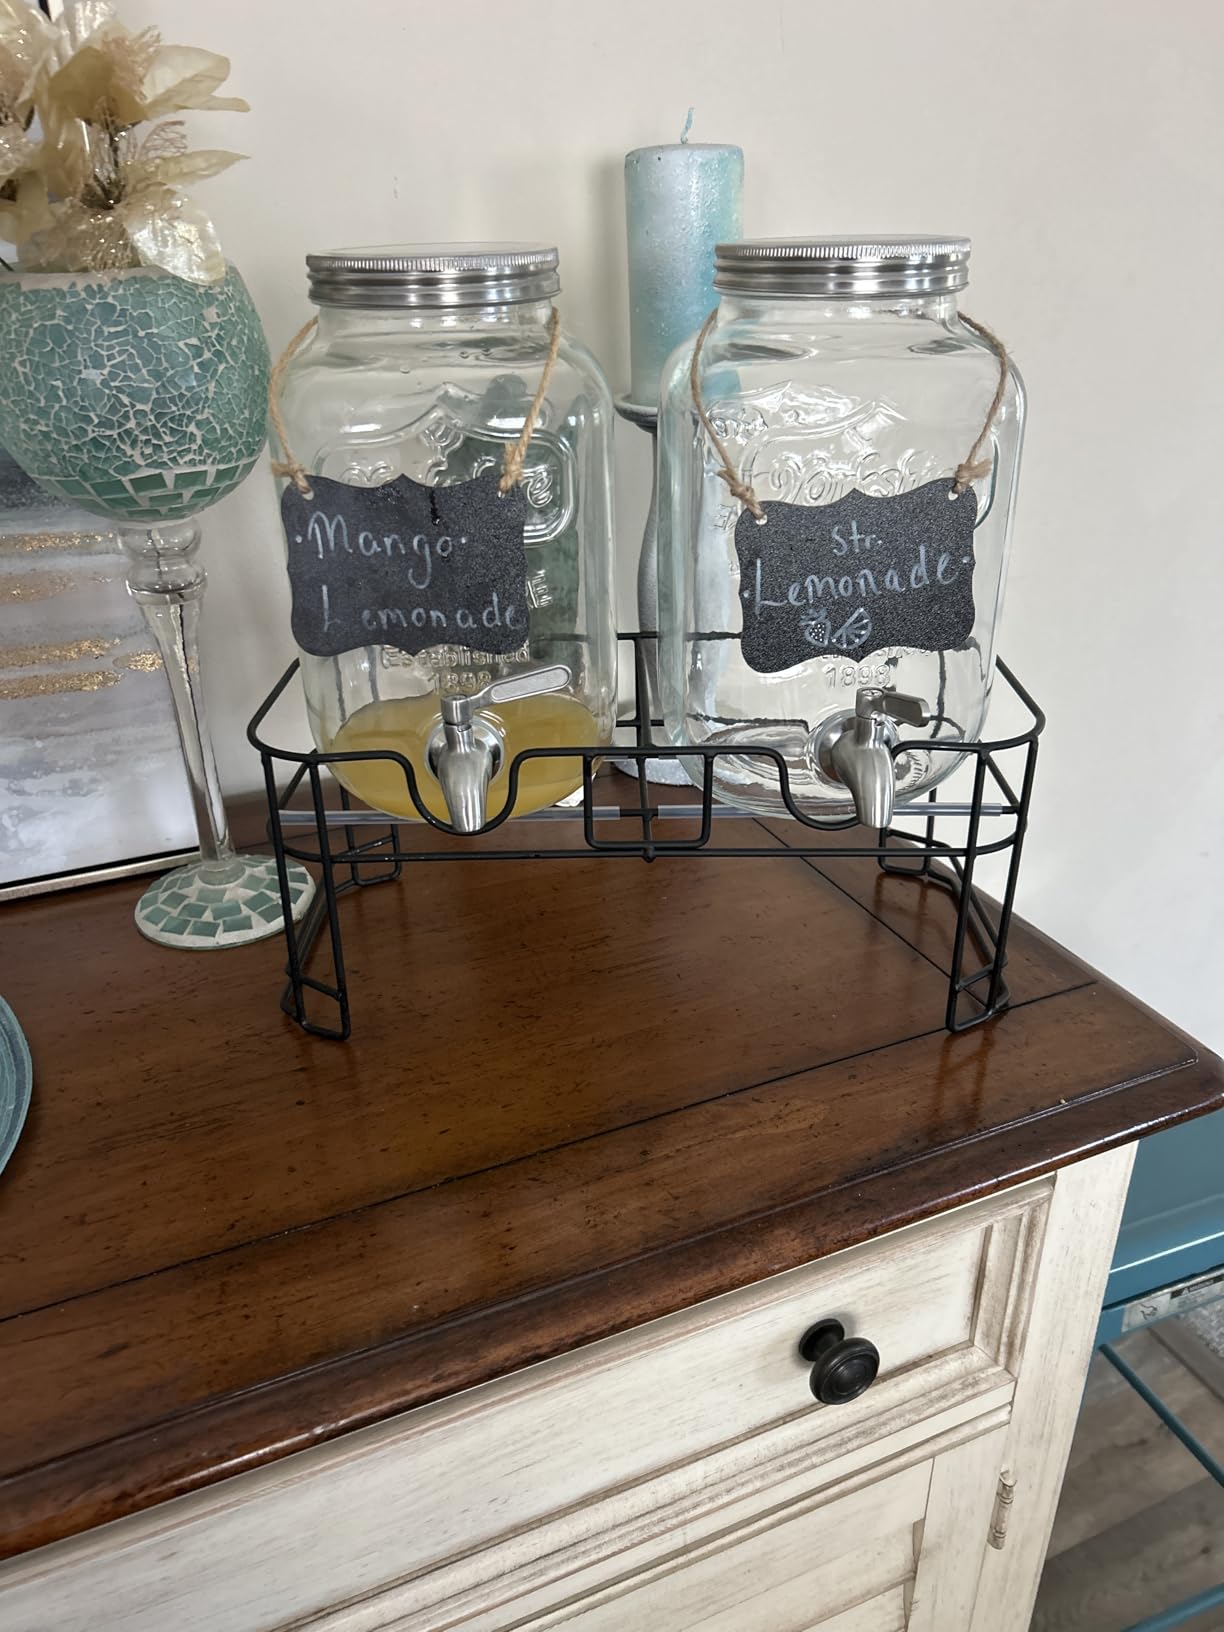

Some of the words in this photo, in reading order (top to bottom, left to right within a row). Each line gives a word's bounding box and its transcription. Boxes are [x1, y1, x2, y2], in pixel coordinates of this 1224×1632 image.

[307, 511, 453, 590] Mango
[755, 546, 959, 618] Lemonade
[322, 584, 521, 633] Lemonade
[428, 671, 491, 694] 1898
[825, 664, 890, 688] 1898
